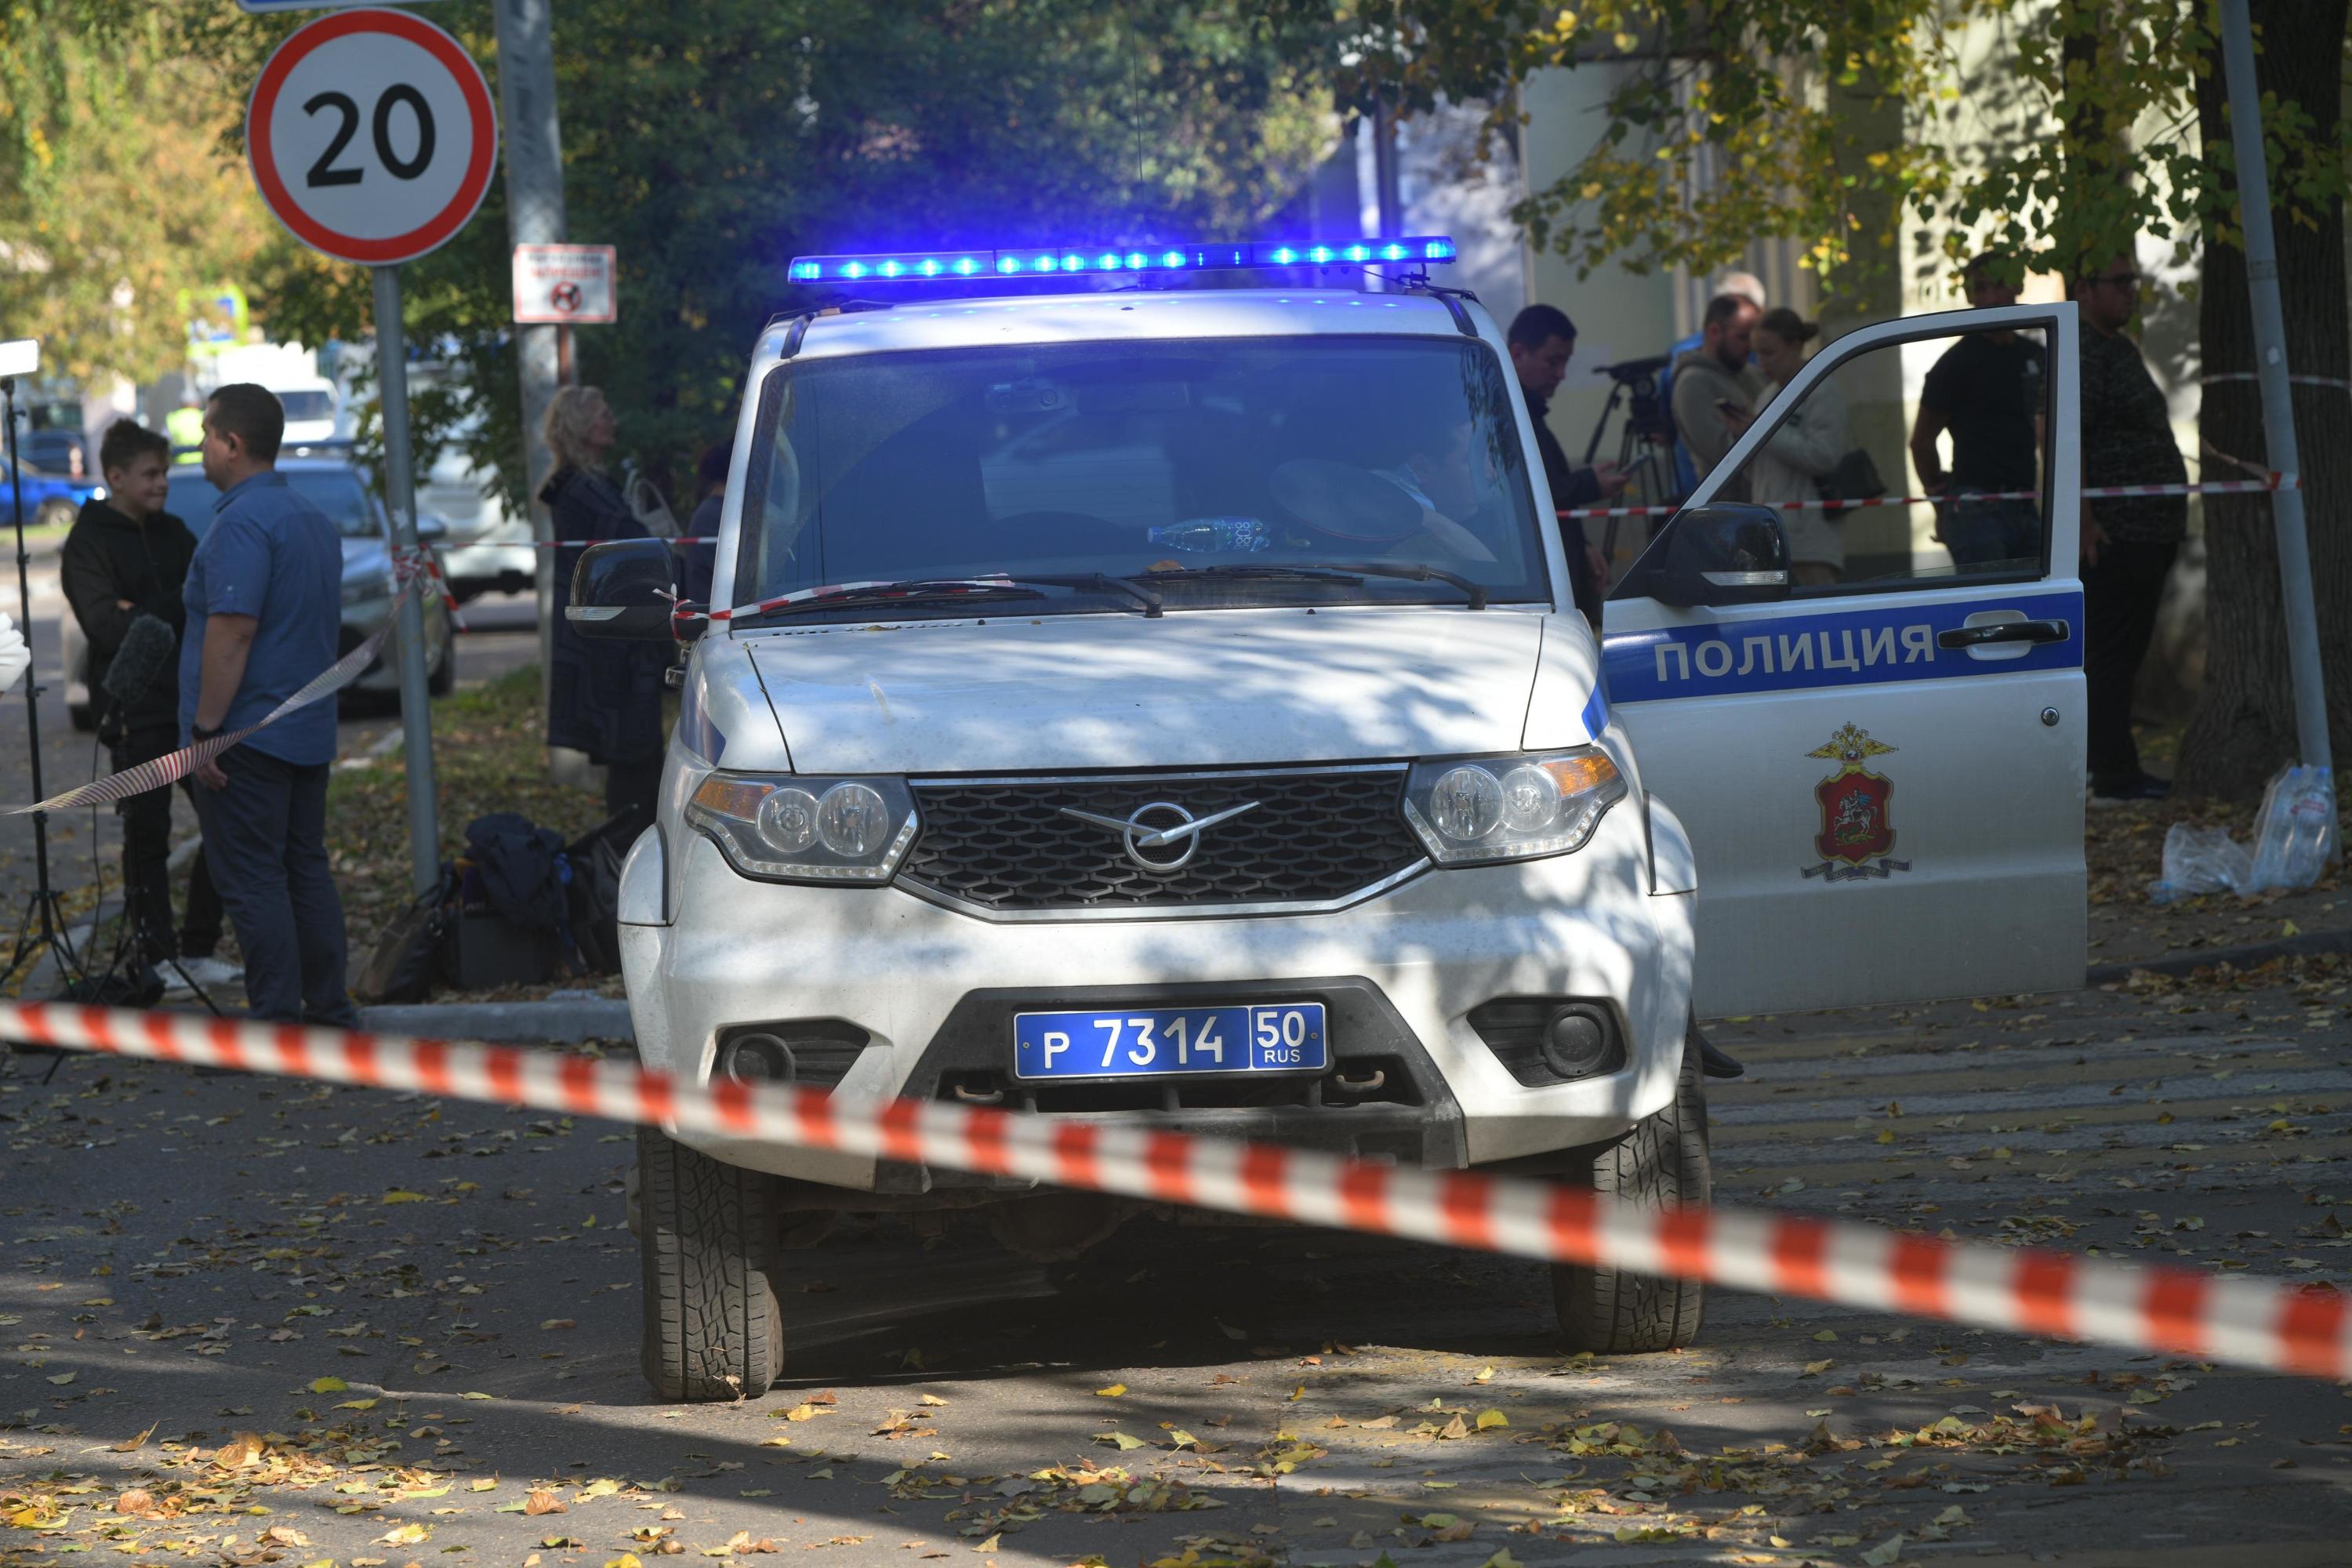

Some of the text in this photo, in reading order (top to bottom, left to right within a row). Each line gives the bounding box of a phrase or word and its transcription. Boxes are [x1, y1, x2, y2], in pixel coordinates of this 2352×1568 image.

[302, 82, 437, 188] 20
[1654, 624, 1936, 682] ПОЛИЦИЯ
[1092, 1015, 1223, 1068] 7314
[1256, 1010, 1305, 1049] 50
[1263, 1049, 1301, 1064] RUS
